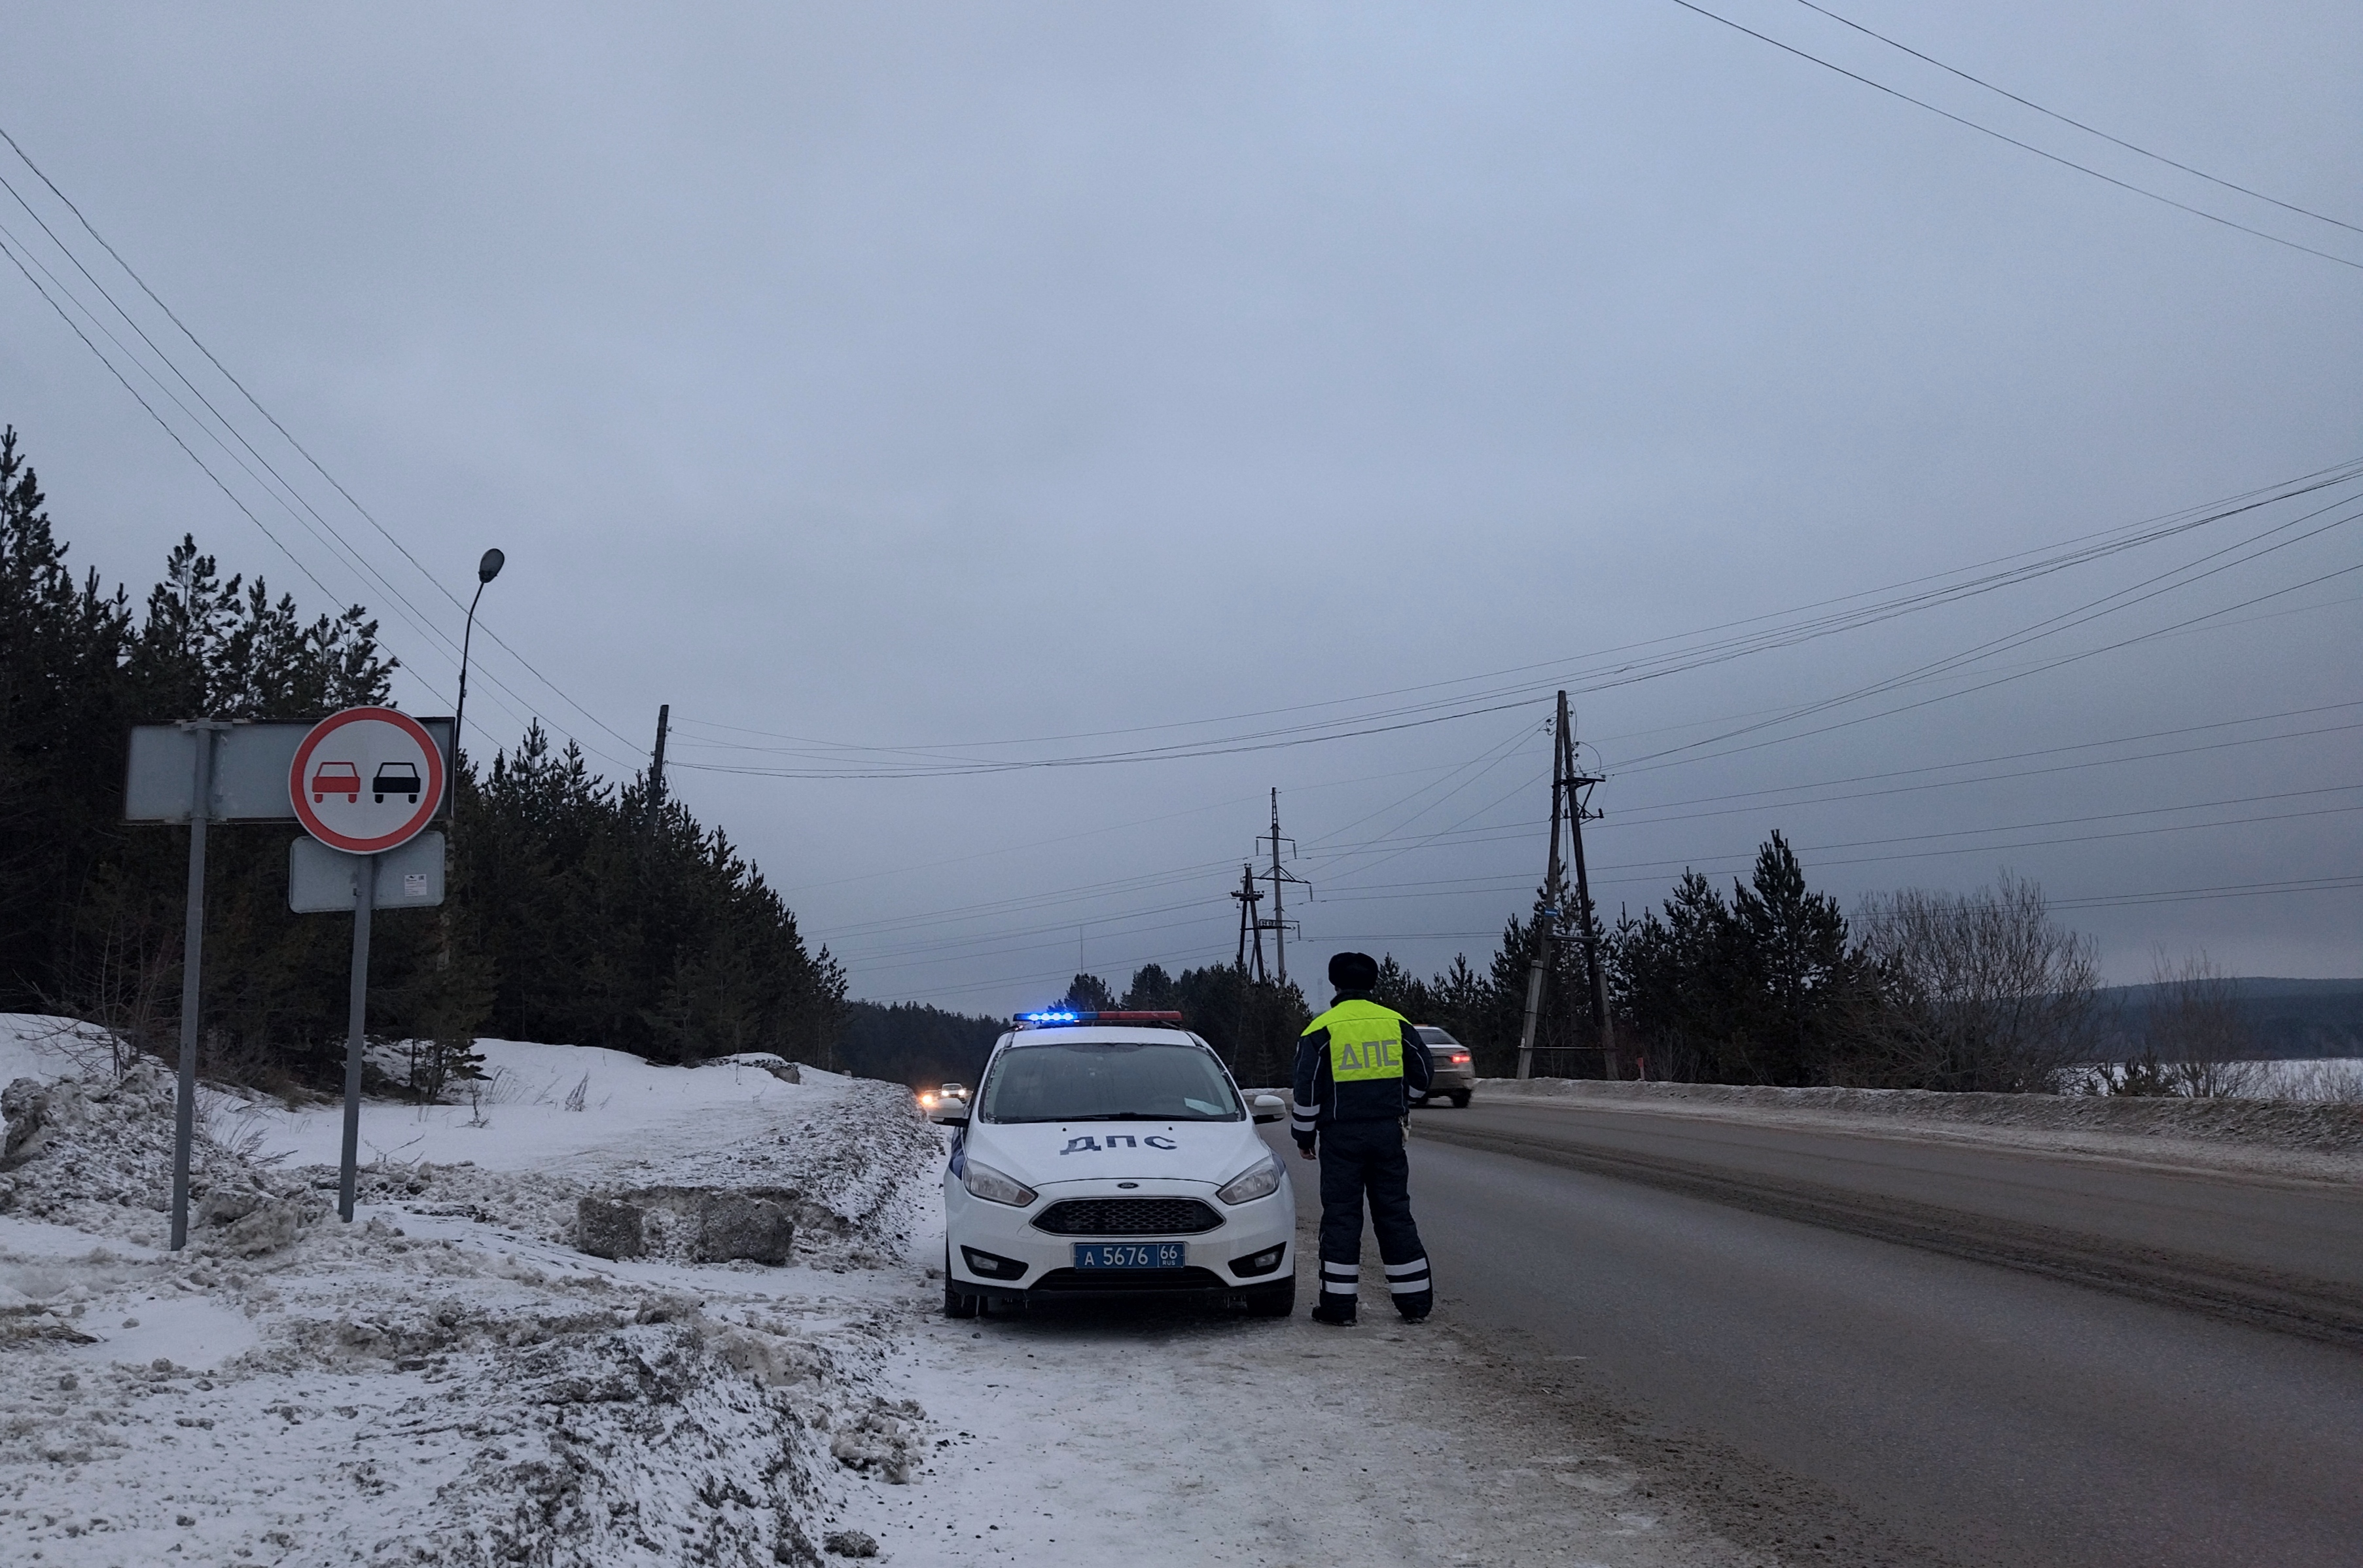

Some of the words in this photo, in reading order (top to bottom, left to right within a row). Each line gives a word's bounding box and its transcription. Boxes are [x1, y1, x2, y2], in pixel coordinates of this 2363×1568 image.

[1338, 1039, 1400, 1071] ДПС
[1059, 1135, 1178, 1155] ДПС
[1103, 1247, 1148, 1266] 5676
[1160, 1245, 1178, 1260] 66
